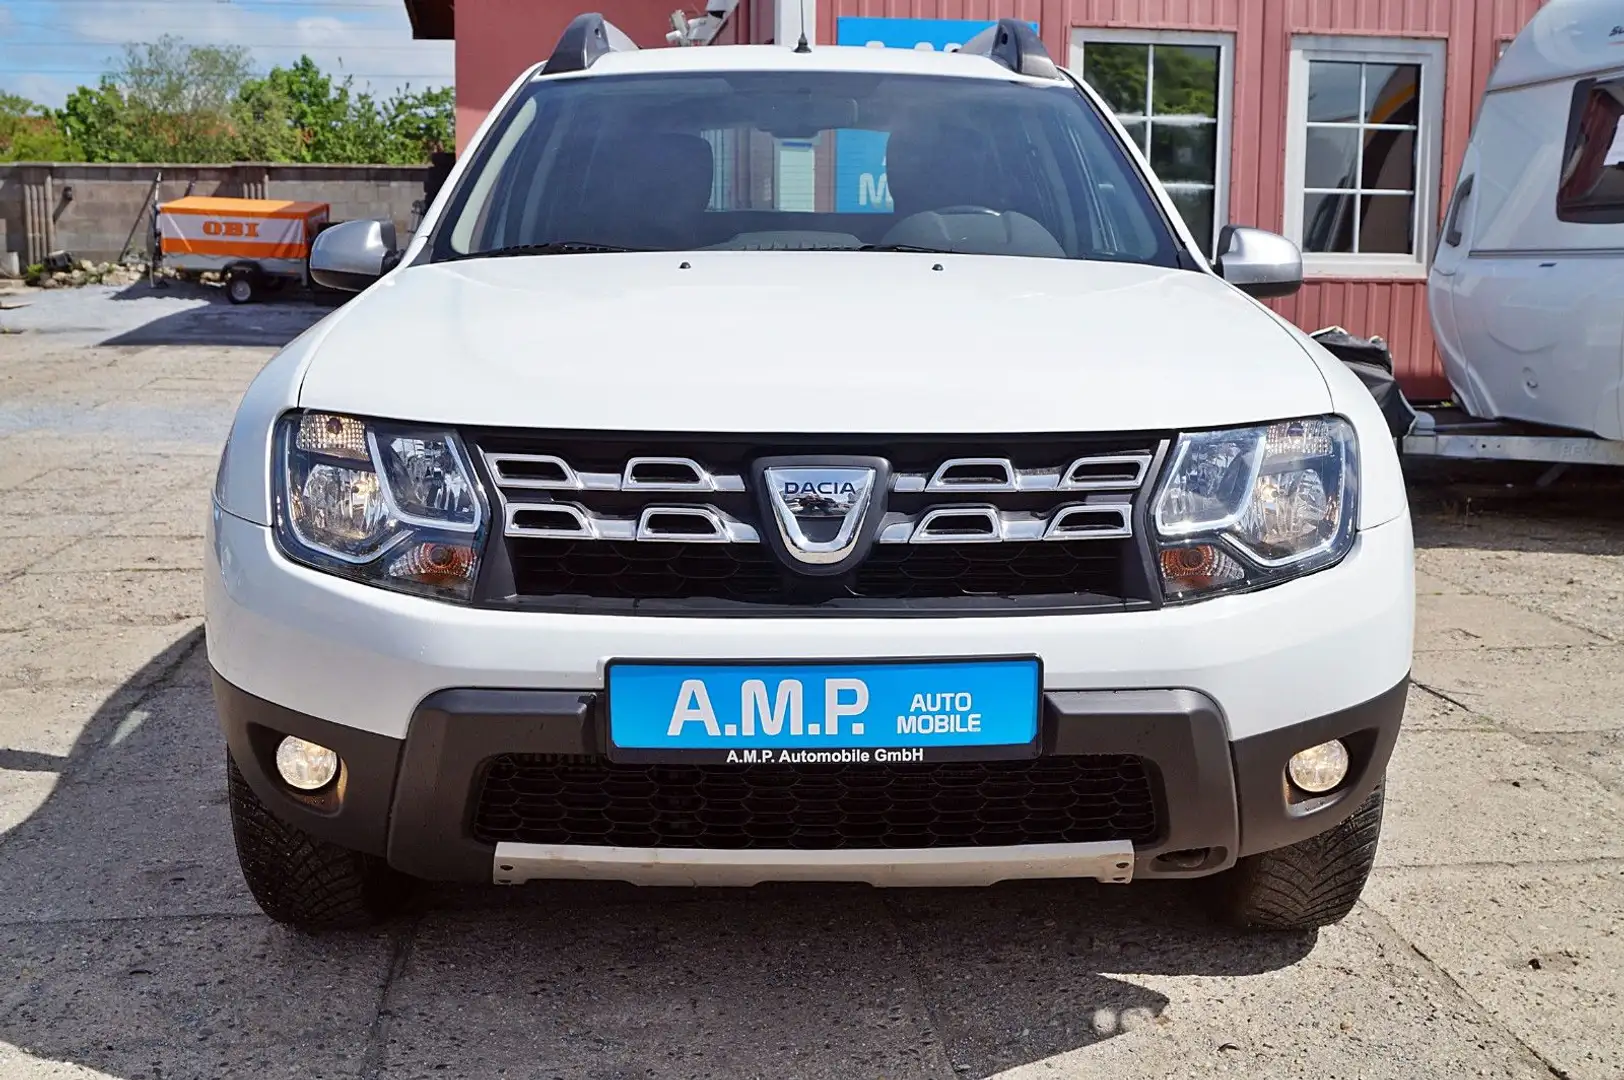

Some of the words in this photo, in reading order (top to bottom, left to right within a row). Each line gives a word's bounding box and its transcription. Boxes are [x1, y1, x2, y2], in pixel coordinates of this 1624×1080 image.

[202, 220, 260, 237] OBI
[784, 482, 857, 495] DACIA
[666, 677, 870, 737] A.M.P.
[909, 692, 972, 713] AUTO
[896, 713, 982, 734] MOBILE
[726, 749, 775, 764] A.M.P.
[779, 748, 870, 763] Automobile
[874, 747, 924, 763] GmbH
